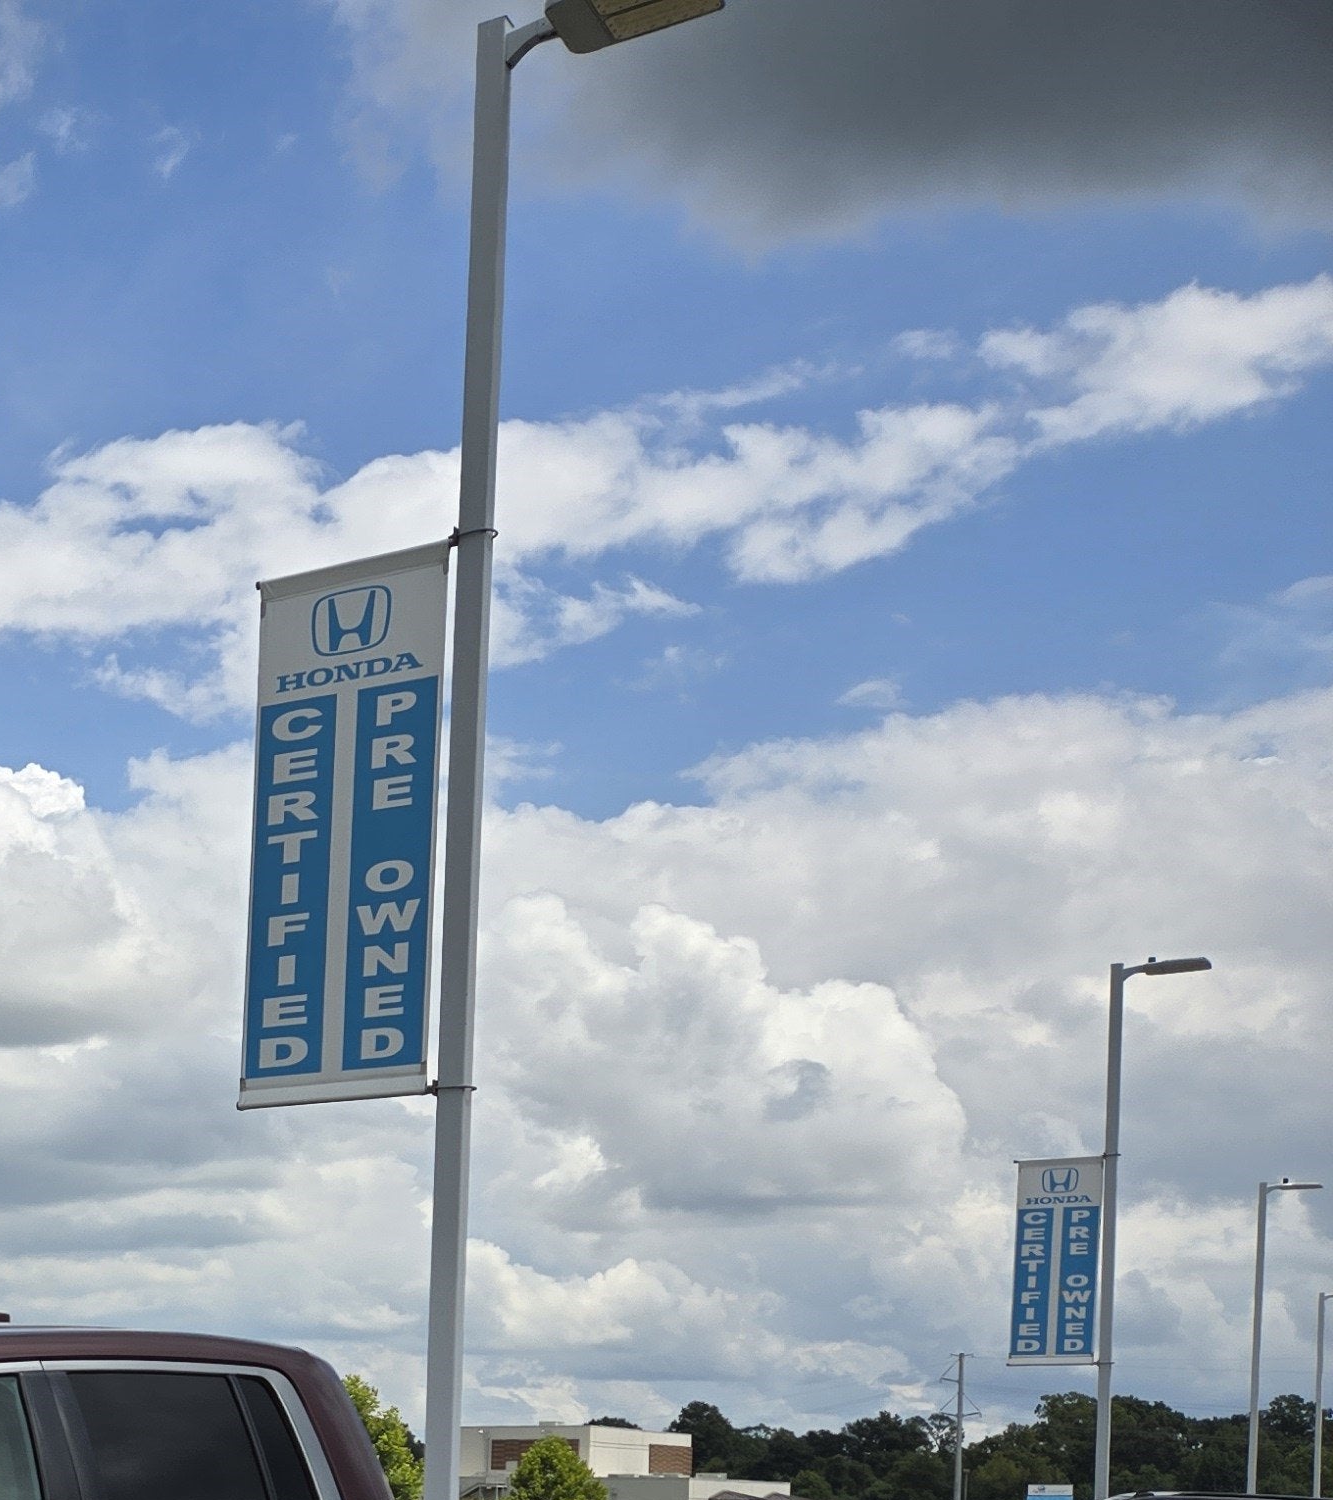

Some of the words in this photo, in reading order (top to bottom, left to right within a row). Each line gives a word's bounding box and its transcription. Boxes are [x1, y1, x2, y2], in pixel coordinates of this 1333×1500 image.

[276, 652, 423, 693] HONDA
[370, 690, 417, 811] PRE
[259, 707, 323, 1070] CERTIFIED
[356, 859, 420, 1061] OWNED
[1026, 1195, 1092, 1205] HONDA
[1069, 1210, 1090, 1255] PRE
[1016, 1211, 1047, 1352] CERTIFIED
[1062, 1274, 1092, 1352] OWNED
